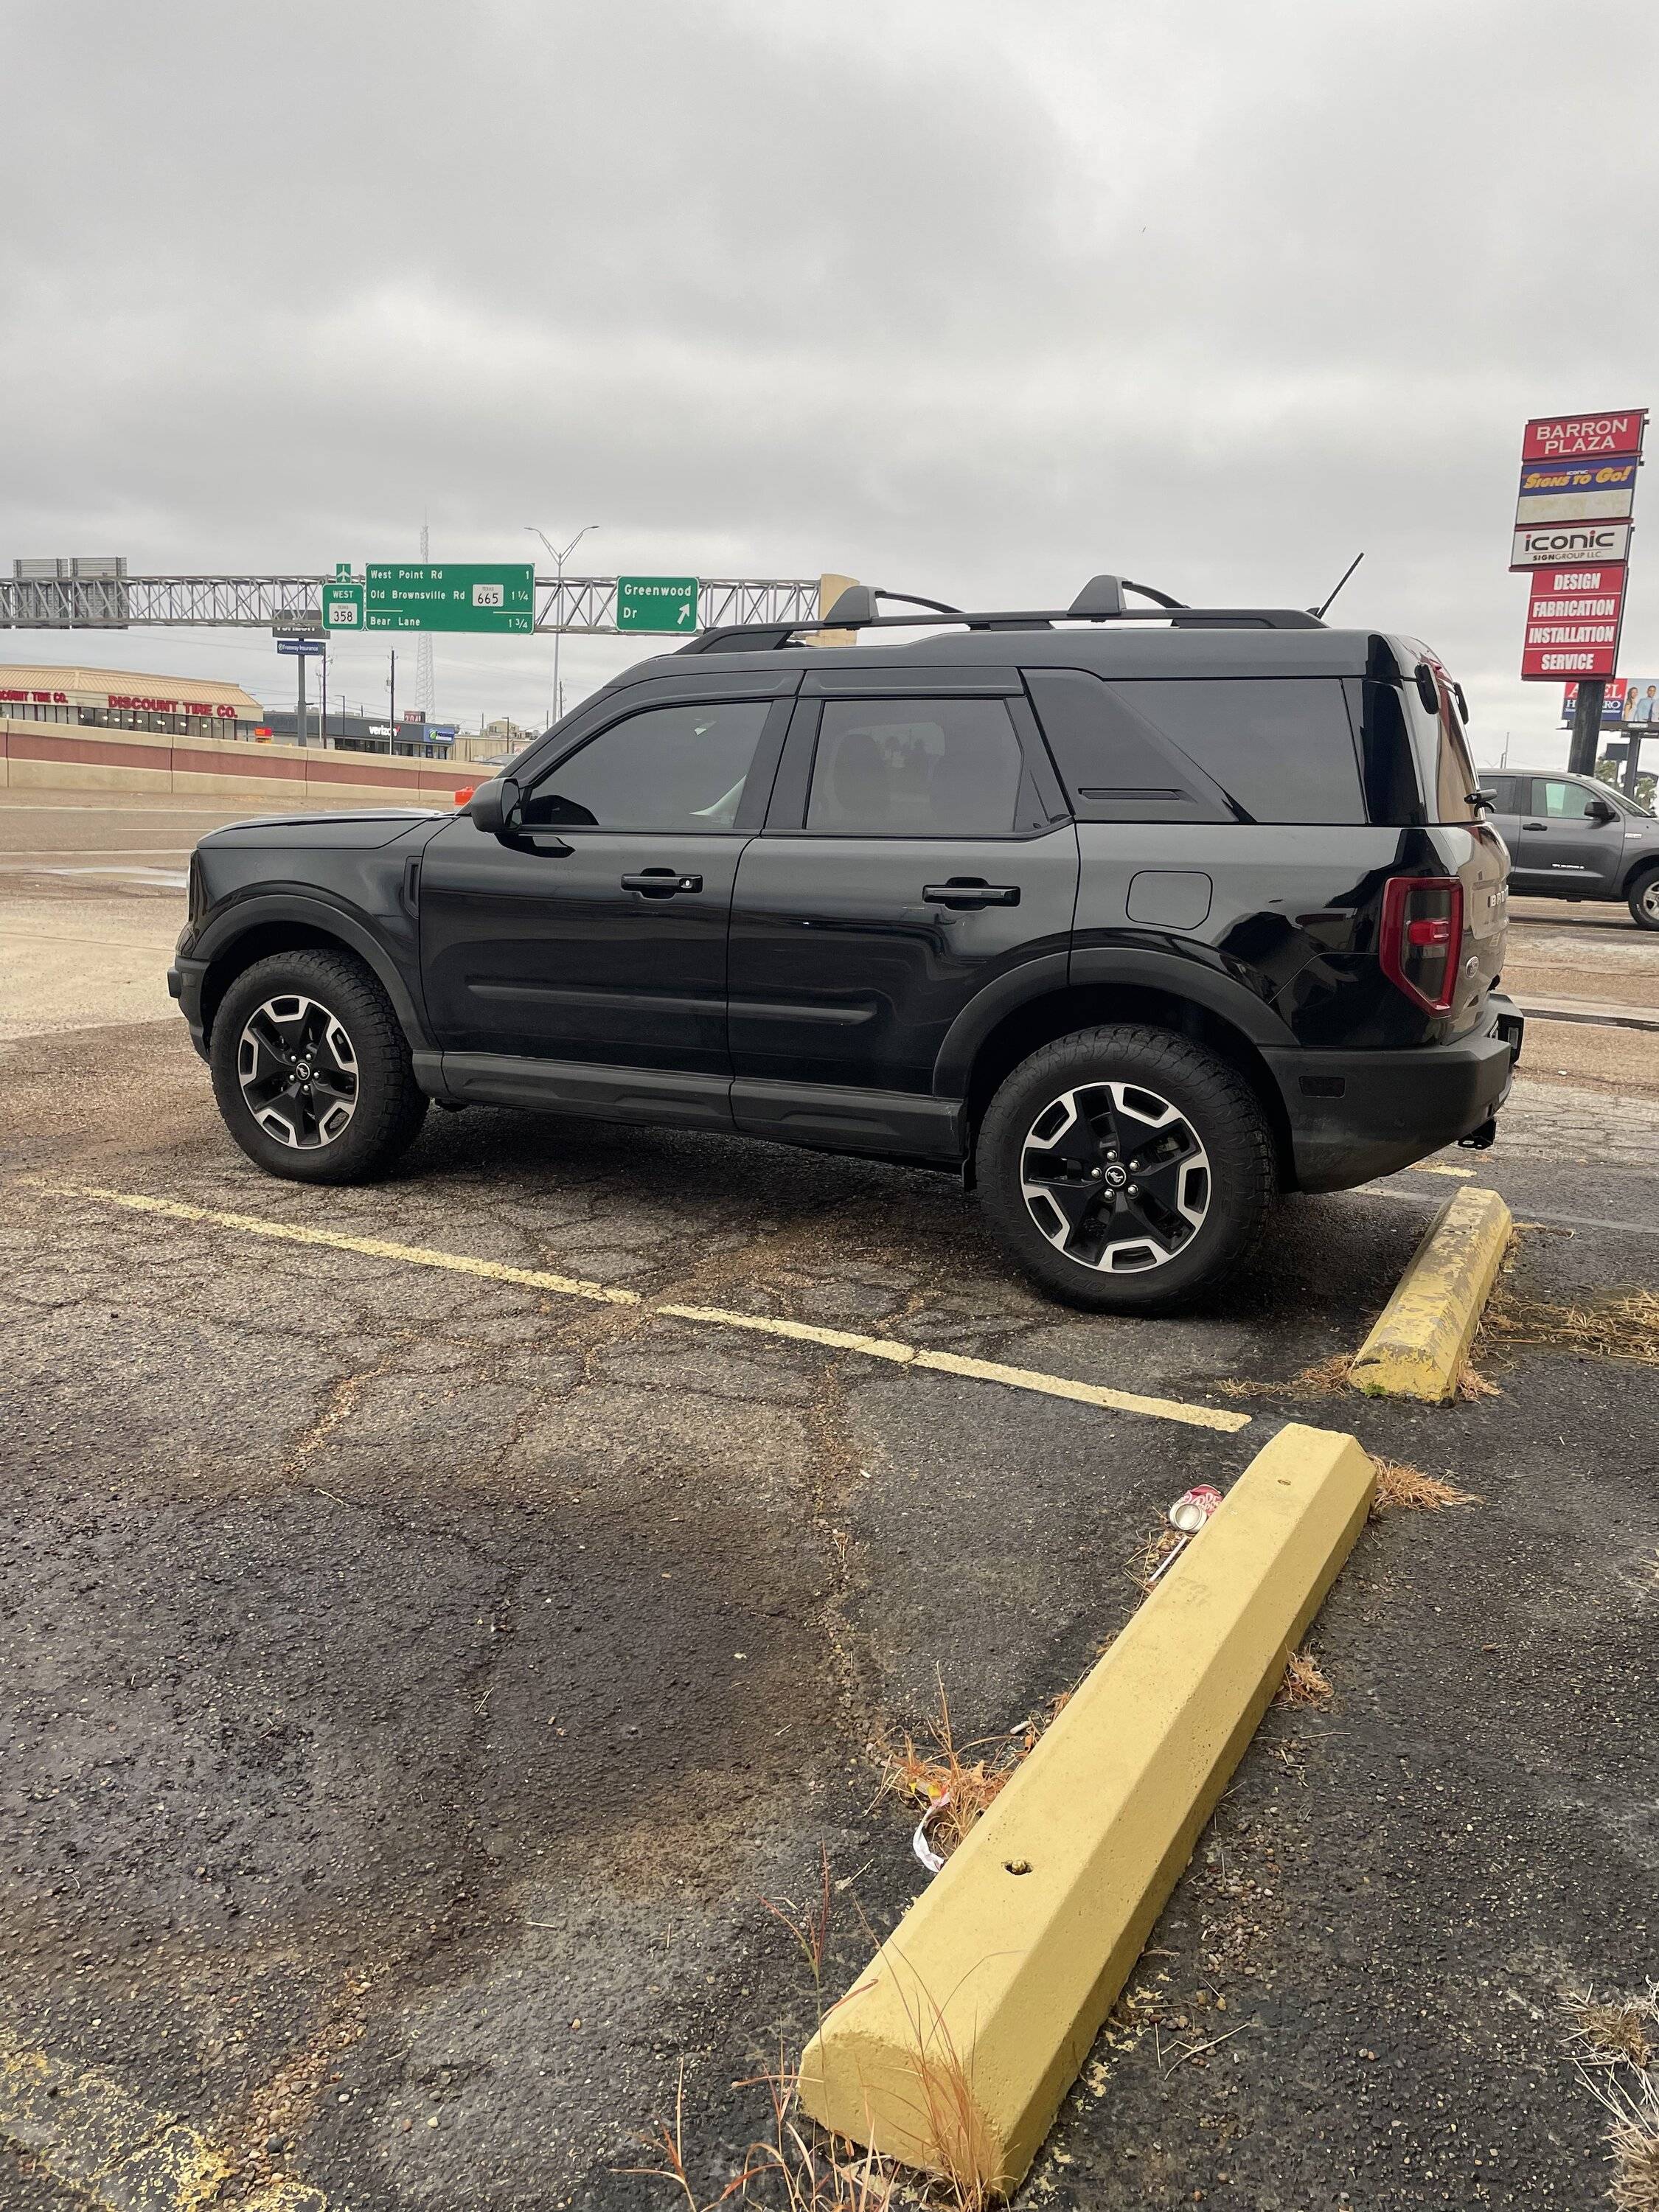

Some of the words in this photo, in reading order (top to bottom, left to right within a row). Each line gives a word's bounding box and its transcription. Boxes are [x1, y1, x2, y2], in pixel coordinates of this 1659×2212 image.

[1536, 418, 1628, 440] BARRON
[1544, 435, 1615, 454] PLAZA
[370, 569, 392, 579] West
[399, 570, 424, 580] Point
[431, 570, 442, 580] Rd
[525, 570, 529, 580] 1
[1554, 572, 1601, 591] DESIGN
[332, 590, 354, 599] WEST
[370, 590, 385, 599] Old
[392, 590, 446, 600] Brownsville
[453, 591, 465, 600] Rd
[624, 583, 692, 597] Greenwood
[477, 593, 498, 605] 665
[623, 607, 638, 619] Dr
[1532, 599, 1615, 618] FABRICATION
[333, 611, 353, 622] 358
[370, 616, 391, 625] Bear
[398, 616, 420, 626] Lane
[1528, 625, 1615, 644] INSTALLATION
[1541, 653, 1595, 670] SERVICE
[108, 695, 179, 713] DISCOUNT
[183, 701, 213, 716] TIRE
[217, 704, 238, 718] CO.
